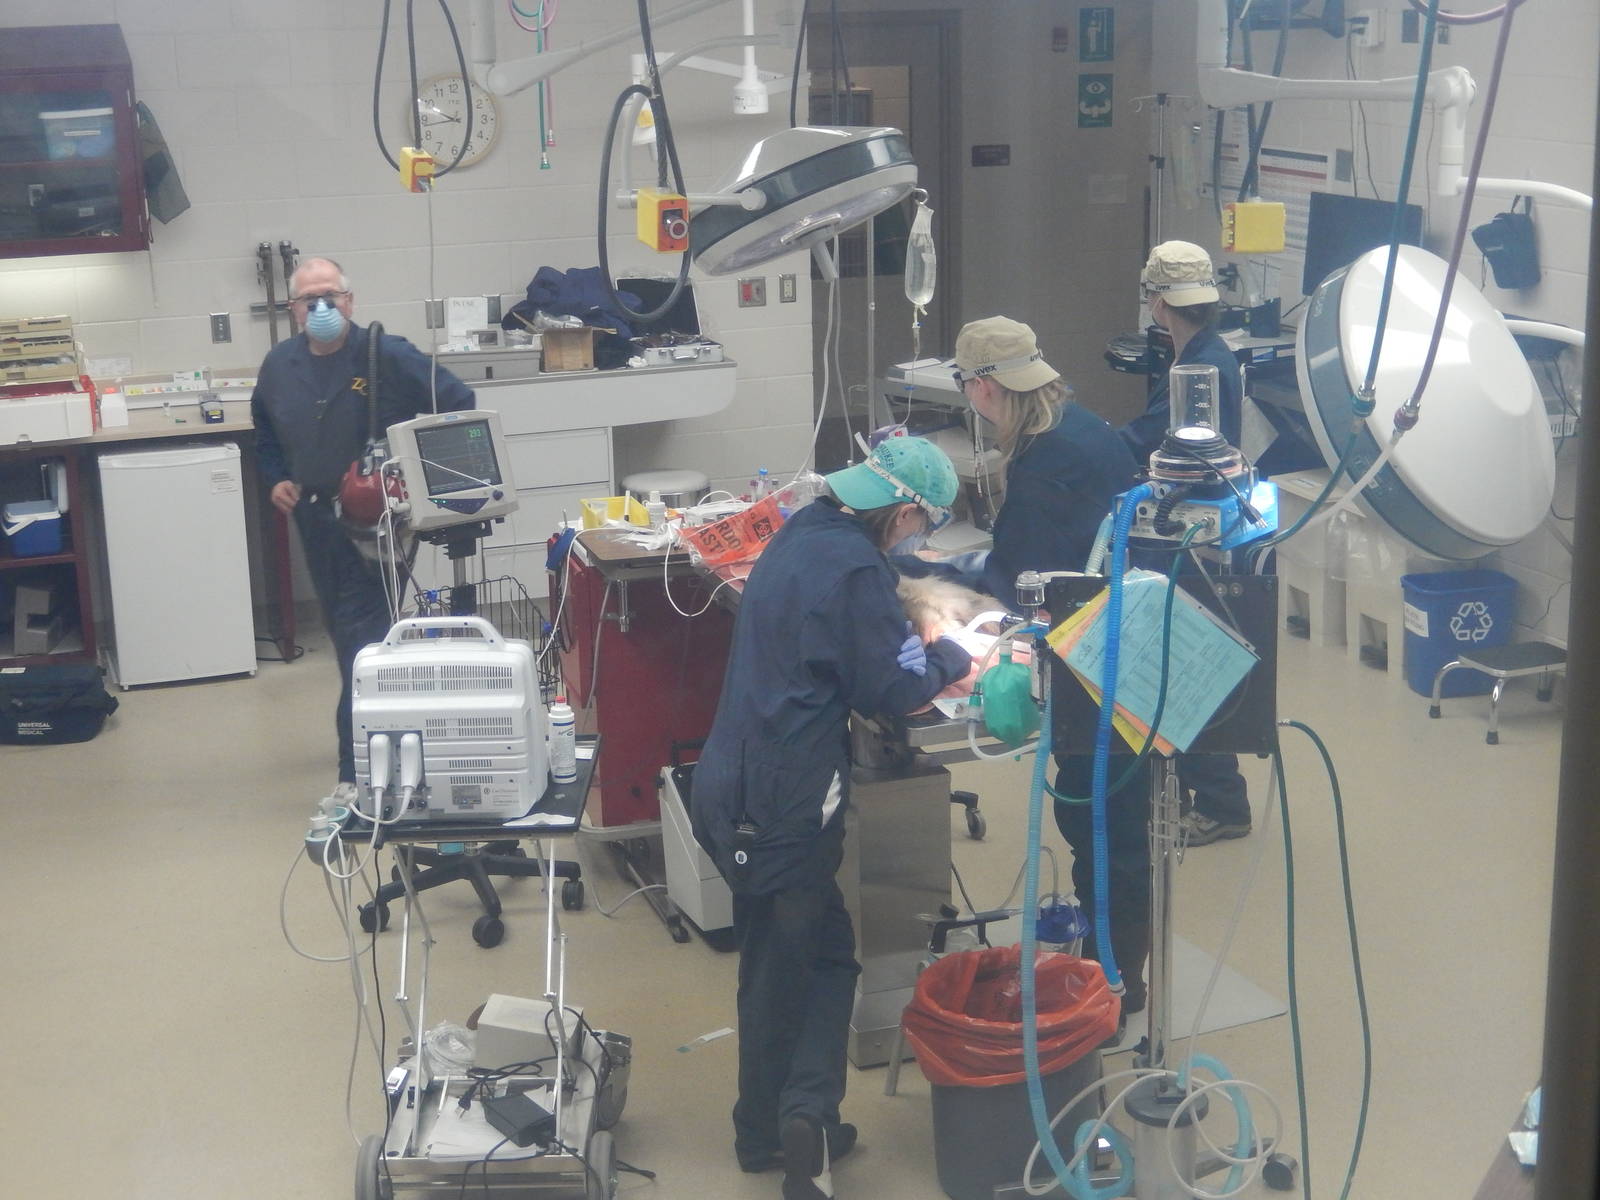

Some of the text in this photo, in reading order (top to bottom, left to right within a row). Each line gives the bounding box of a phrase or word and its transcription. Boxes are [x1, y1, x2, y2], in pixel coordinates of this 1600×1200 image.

[434, 88, 444, 98] 11
[448, 84, 459, 94] 12
[476, 99, 483, 109] 2
[421, 115, 428, 125] 9
[481, 114, 488, 124] 3
[425, 130, 432, 140] 8
[477, 130, 484, 139] 4
[436, 142, 443, 152] 7
[451, 145, 458, 155] 6
[974, 364, 997, 376] uvex
